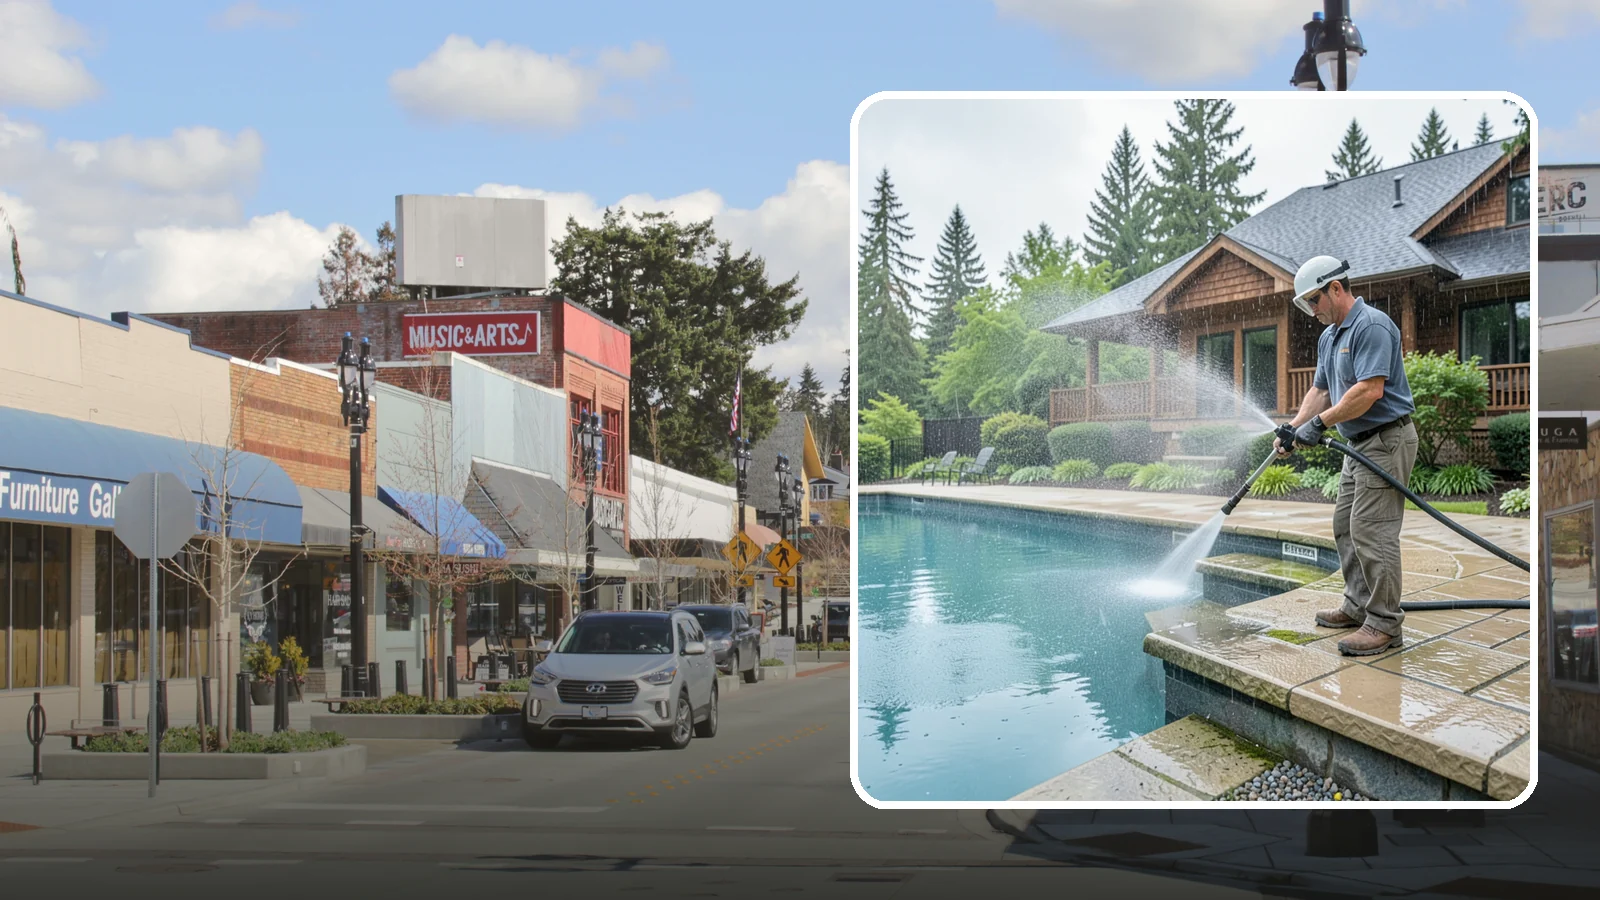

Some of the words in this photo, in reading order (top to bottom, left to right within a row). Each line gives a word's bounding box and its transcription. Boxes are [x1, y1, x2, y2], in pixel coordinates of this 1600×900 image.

[409, 323, 519, 348] MUSIC&ARTS
[0, 472, 79, 514] Furniture
[89, 483, 121, 518] Gal
[453, 563, 479, 574] SUSHI
